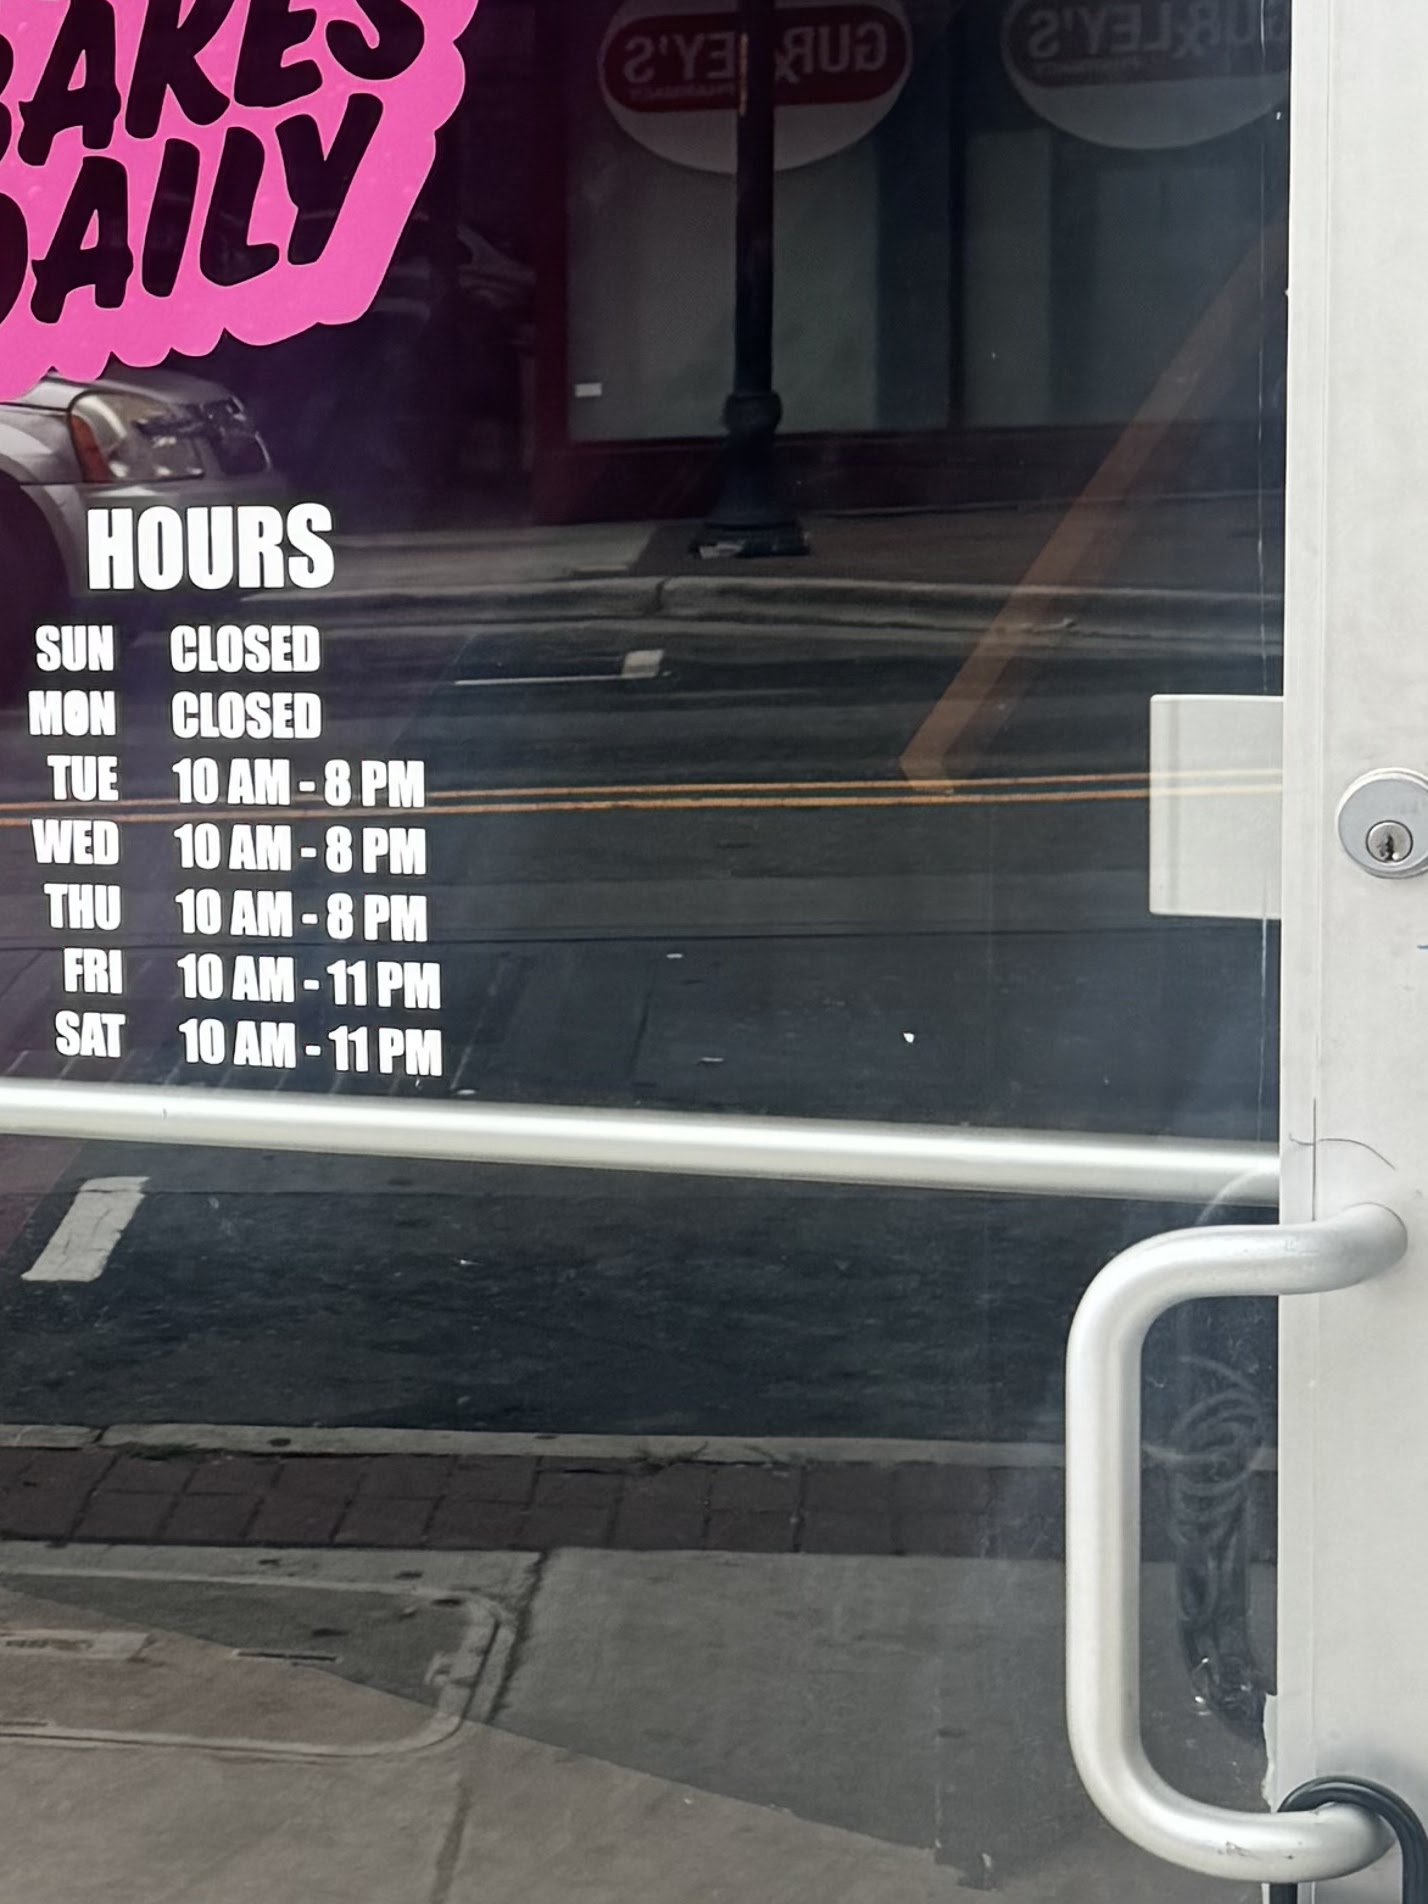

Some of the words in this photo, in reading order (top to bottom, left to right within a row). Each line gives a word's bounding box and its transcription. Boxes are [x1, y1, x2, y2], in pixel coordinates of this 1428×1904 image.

[86, 502, 336, 590] HOURS
[35, 624, 115, 672] SUN
[169, 624, 321, 673] CLOSED
[28, 690, 117, 736] MON
[171, 691, 323, 739] CLOSED
[47, 755, 119, 802] TUE
[171, 757, 221, 804] 10
[226, 758, 291, 806] AM
[298, 779, 316, 793] -
[324, 759, 351, 806] 8
[361, 759, 426, 808] PM
[31, 818, 120, 865] WED
[174, 823, 221, 870] 10
[228, 824, 292, 872] AM
[300, 847, 318, 859] -
[325, 825, 353, 875] 8
[362, 827, 427, 876] PM
[44, 884, 122, 930] THU
[175, 888, 223, 936] 10
[229, 890, 294, 939] AM
[301, 911, 318, 925] -
[326, 892, 354, 942] 8
[363, 893, 429, 943] PM
[62, 947, 123, 995] FRI
[176, 953, 225, 1001] 10
[231, 956, 295, 1003] AM
[304, 978, 320, 991] -
[327, 959, 368, 1007] 11
[377, 960, 442, 1010] PM
[54, 1011, 127, 1059] SAT
[178, 1018, 225, 1066] 10
[232, 1020, 296, 1070] AM
[305, 1044, 322, 1057] -
[328, 1024, 370, 1073] 11
[378, 1026, 443, 1077] PM
